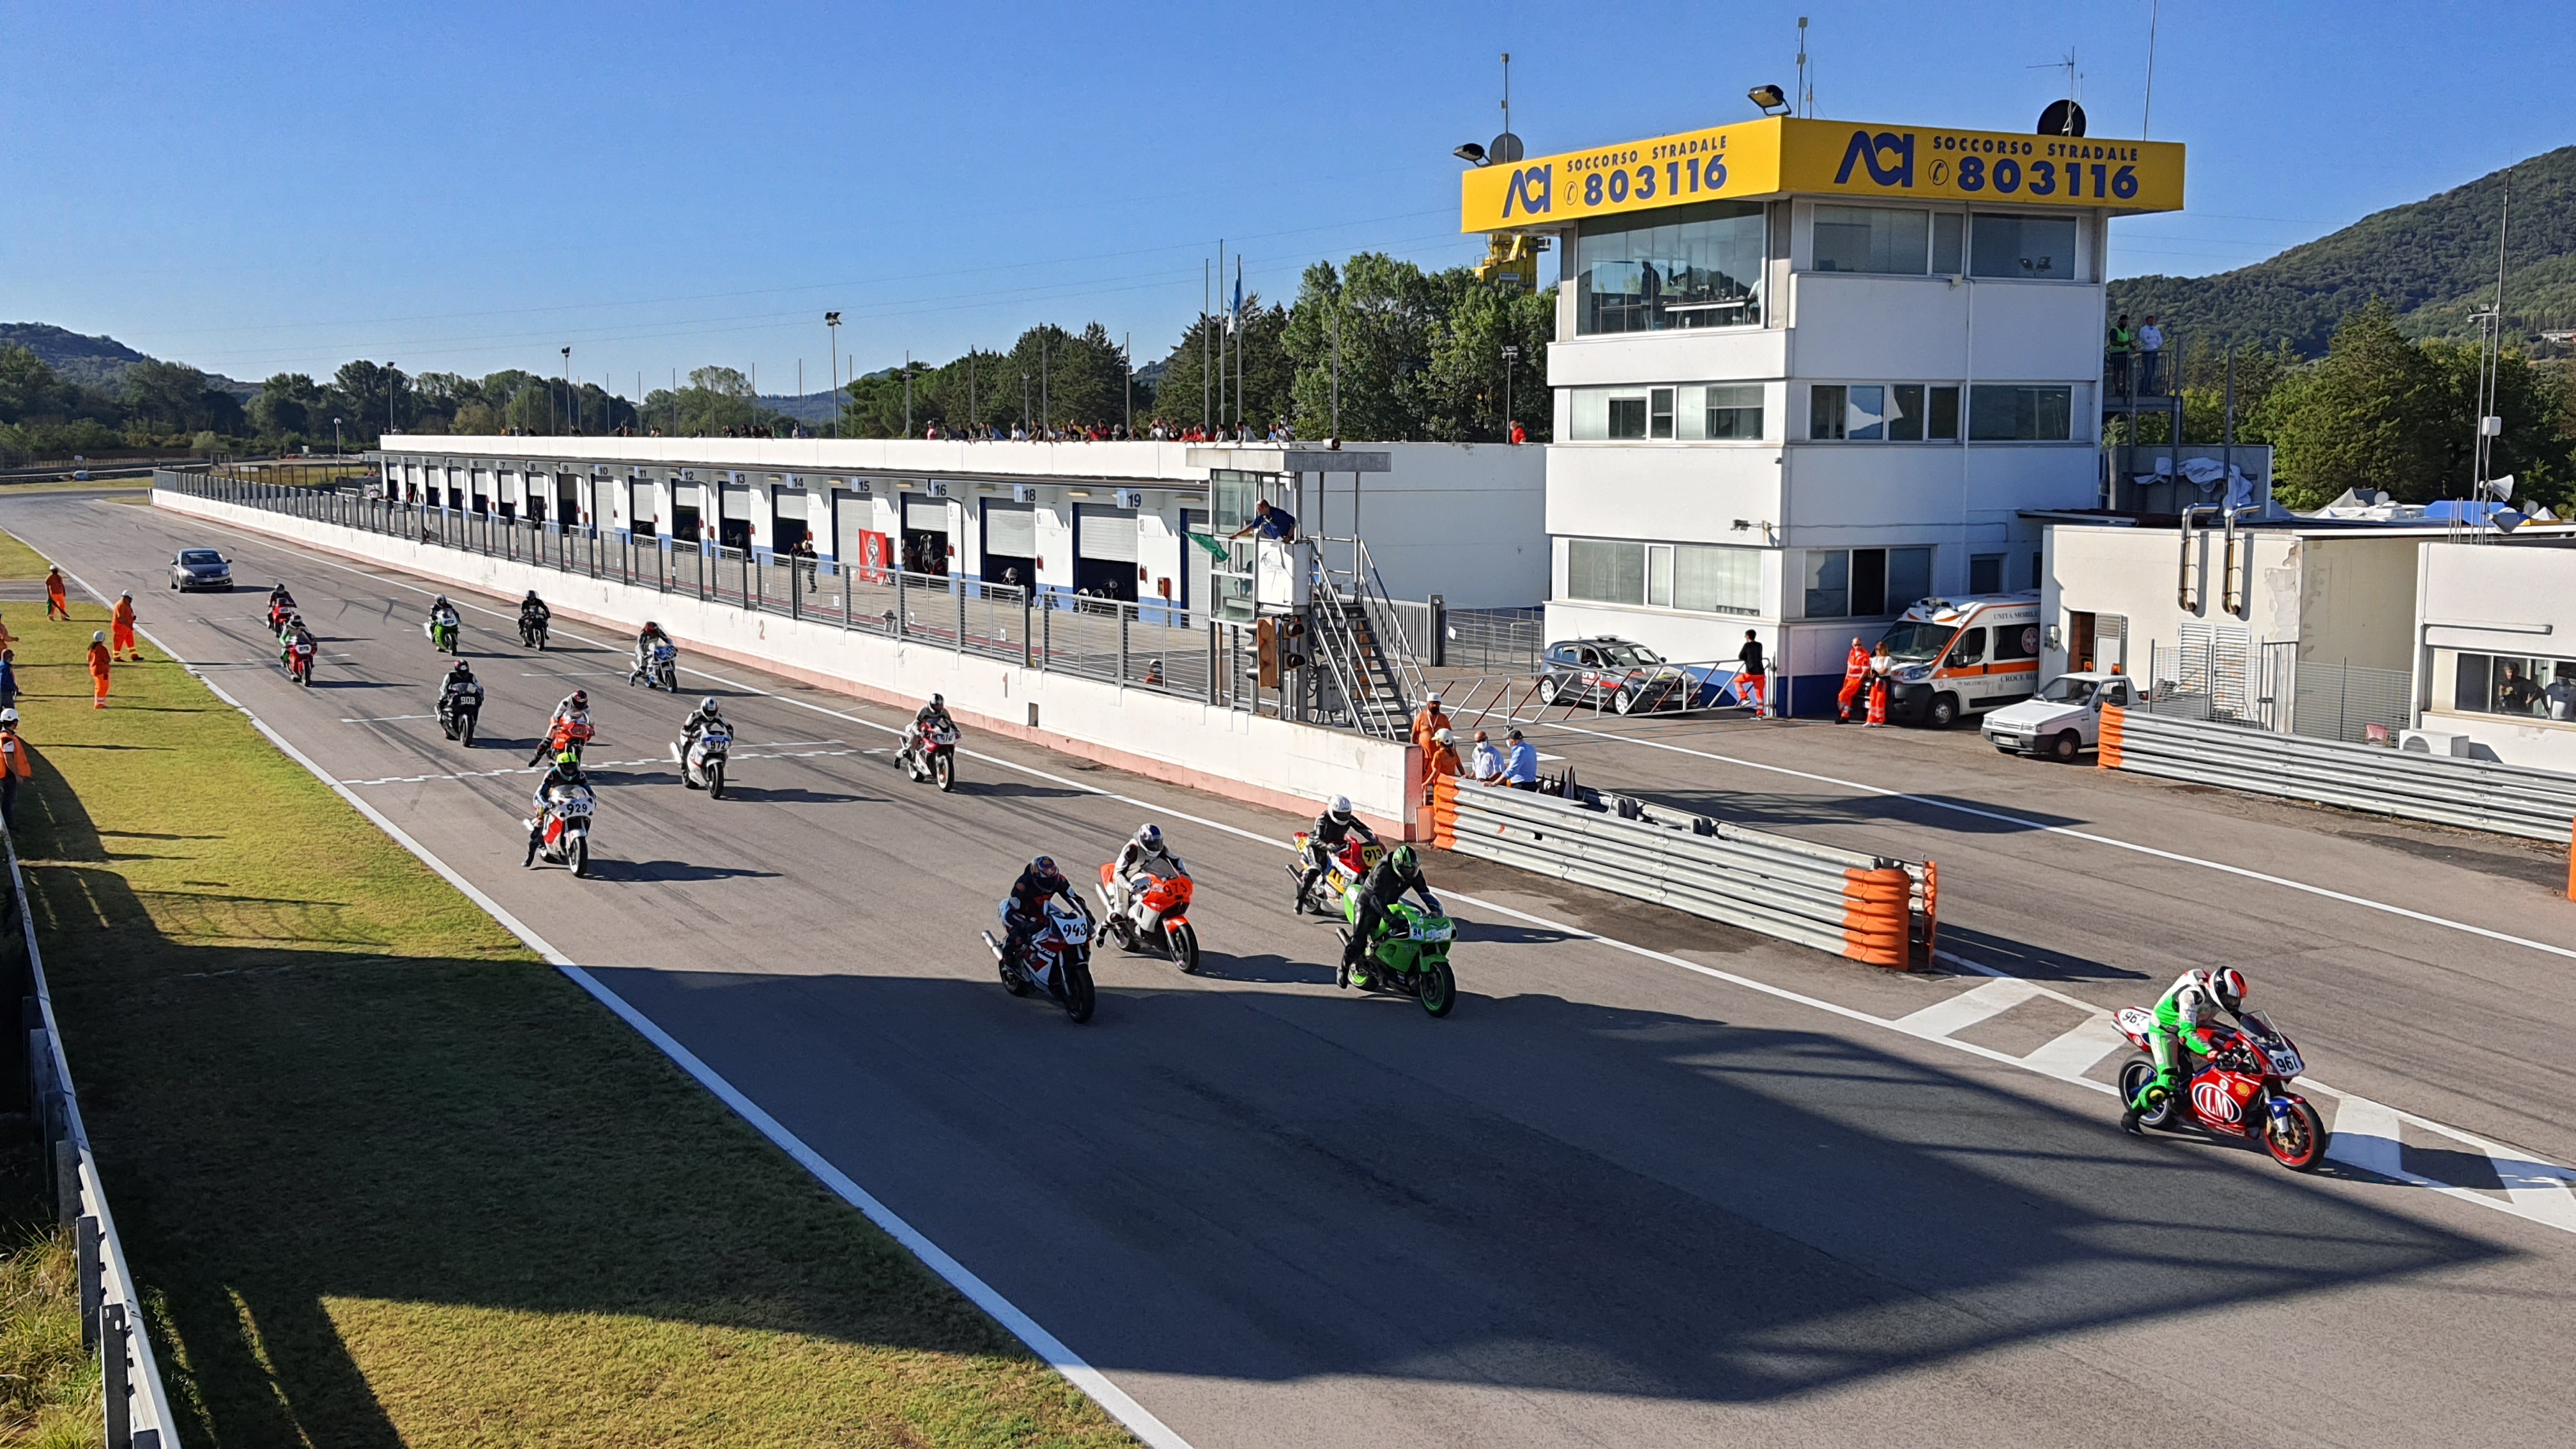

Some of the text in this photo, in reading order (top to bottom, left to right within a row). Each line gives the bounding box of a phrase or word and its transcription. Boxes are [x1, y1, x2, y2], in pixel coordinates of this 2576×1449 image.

[1567, 135, 1726, 172] SOCCORSO STRADALE
[1933, 135, 2137, 161] SOCCORSO STRADALE
[1834, 130, 1914, 187] ACI
[1584, 153, 1727, 206] 803116
[1958, 156, 2138, 199] 803116
[1502, 164, 1551, 218] ACI
[599, 467, 608, 475] 10
[639, 469, 647, 477] 11
[684, 471, 694, 480] 12
[735, 474, 745, 484] 13
[793, 477, 804, 487] 14
[859, 481, 870, 491] 15
[935, 484, 946, 496] 16
[1024, 489, 1036, 502] 18
[1128, 493, 1141, 507] 19
[760, 620, 765, 640] 2
[2000, 674, 2025, 683] CROCE
[710, 740, 726, 749] 972
[567, 803, 588, 815] 929
[1363, 848, 1383, 862] 913
[1062, 923, 1087, 938] 943
[2275, 1055, 2299, 1073] 967
